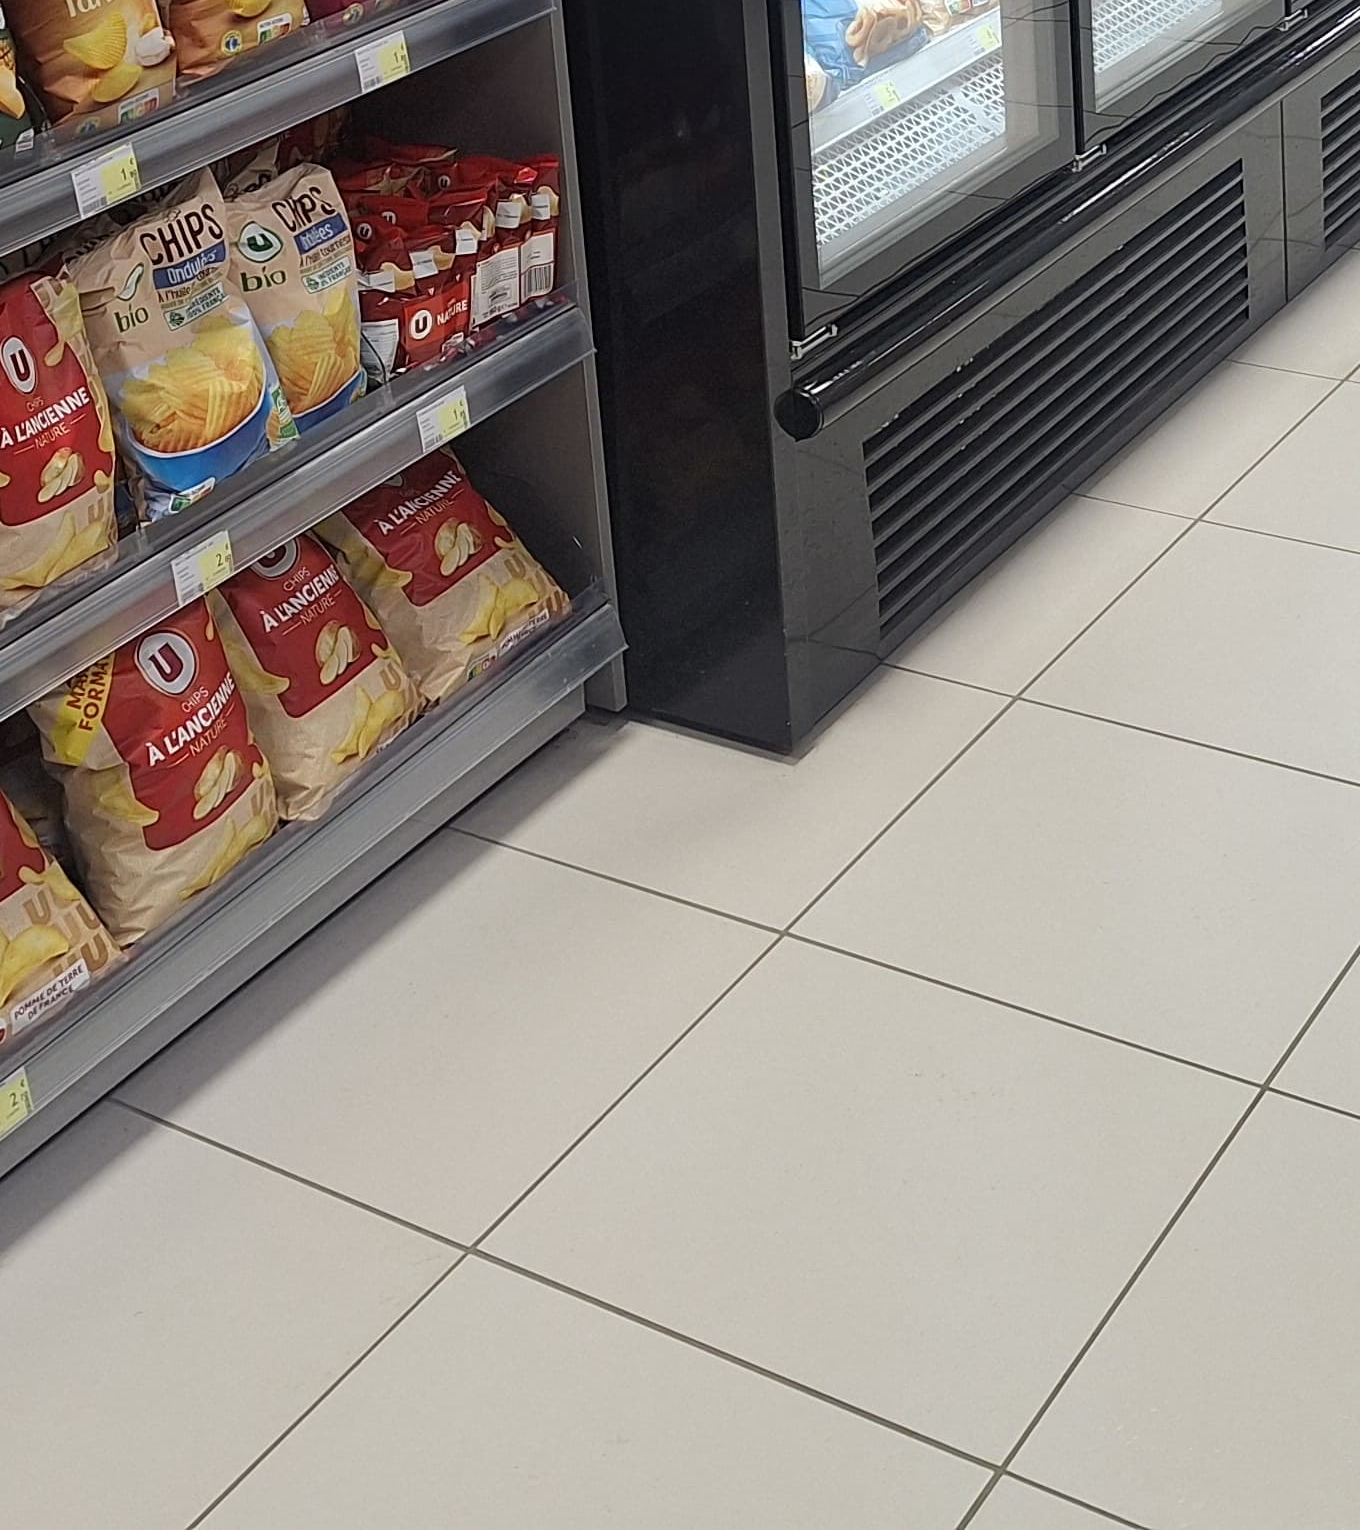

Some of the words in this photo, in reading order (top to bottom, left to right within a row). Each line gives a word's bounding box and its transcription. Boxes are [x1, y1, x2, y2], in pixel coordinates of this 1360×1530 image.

[140, 203, 224, 267] CHIPS
[240, 266, 287, 292] bio
[114, 303, 149, 334] bio
[414, 315, 428, 335] U
[437, 299, 468, 326] NATURE
[14, 386, 90, 442] L'ANCIENNE
[34, 421, 71, 451] NATURE
[298, 589, 337, 627] NATURE
[161, 670, 235, 759] L'ANCIENNE
[181, 686, 211, 713] CHIPS
[188, 716, 228, 759] NATURE
